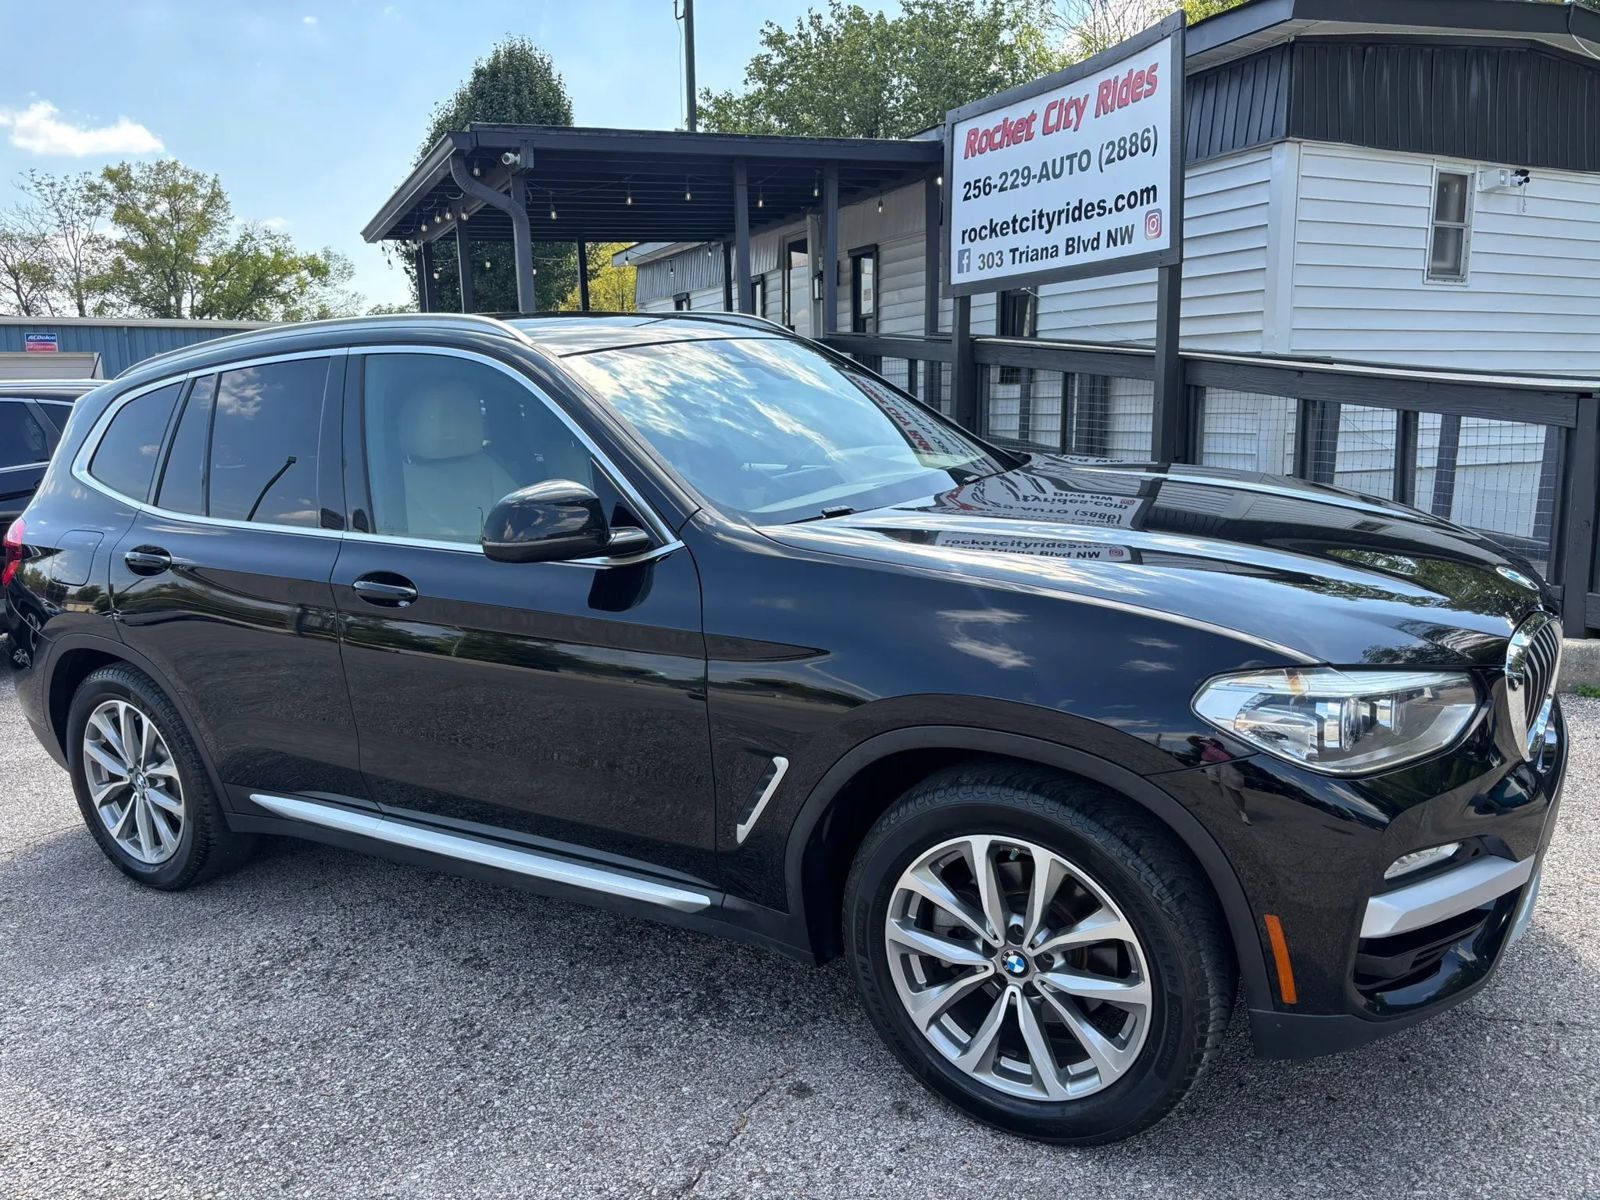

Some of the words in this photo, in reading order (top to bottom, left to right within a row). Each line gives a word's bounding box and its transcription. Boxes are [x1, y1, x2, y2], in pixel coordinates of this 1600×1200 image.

[964, 109, 1038, 160] Rocket
[1042, 93, 1090, 136] City
[1094, 62, 1159, 119] Rides
[962, 148, 1091, 202] 256-229-AUTO
[1099, 124, 1159, 173] (2886)
[961, 184, 1158, 245] rocketcityrides.com
[978, 249, 1004, 271] 303
[1009, 244, 1059, 265] Triana
[1065, 231, 1100, 256] Blvd
[1106, 223, 1135, 248] NW
[1076, 551, 1101, 559] NW
